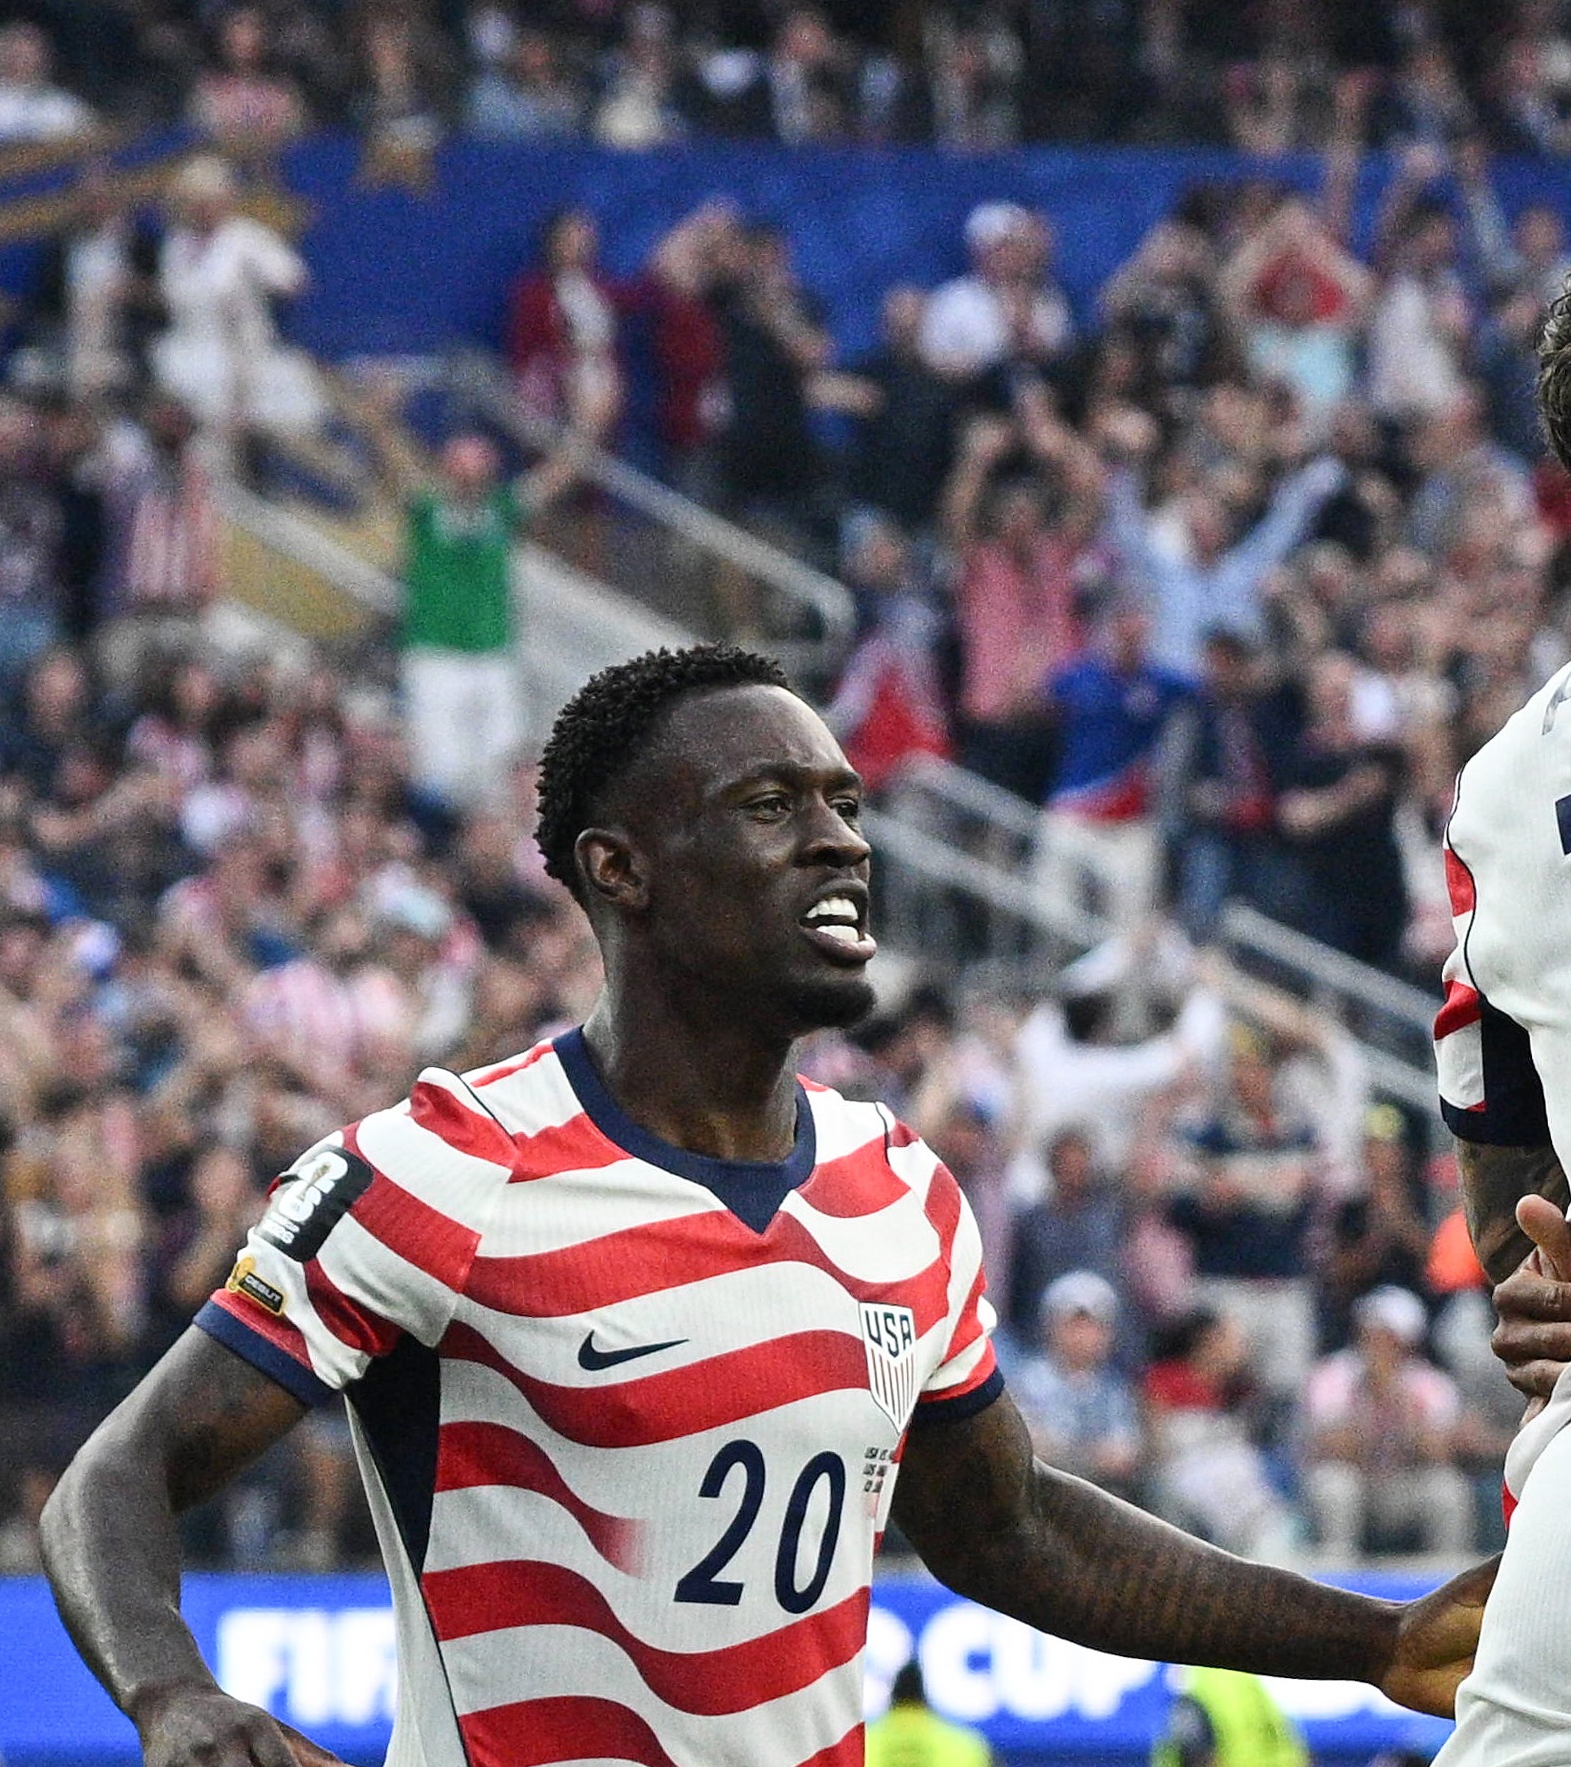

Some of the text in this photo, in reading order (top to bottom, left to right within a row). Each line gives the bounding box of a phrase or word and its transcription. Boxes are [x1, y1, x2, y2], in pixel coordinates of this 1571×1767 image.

[865, 1310, 913, 1358] USA
[673, 1439, 846, 1614] 20
[217, 1607, 397, 1728] FIF
